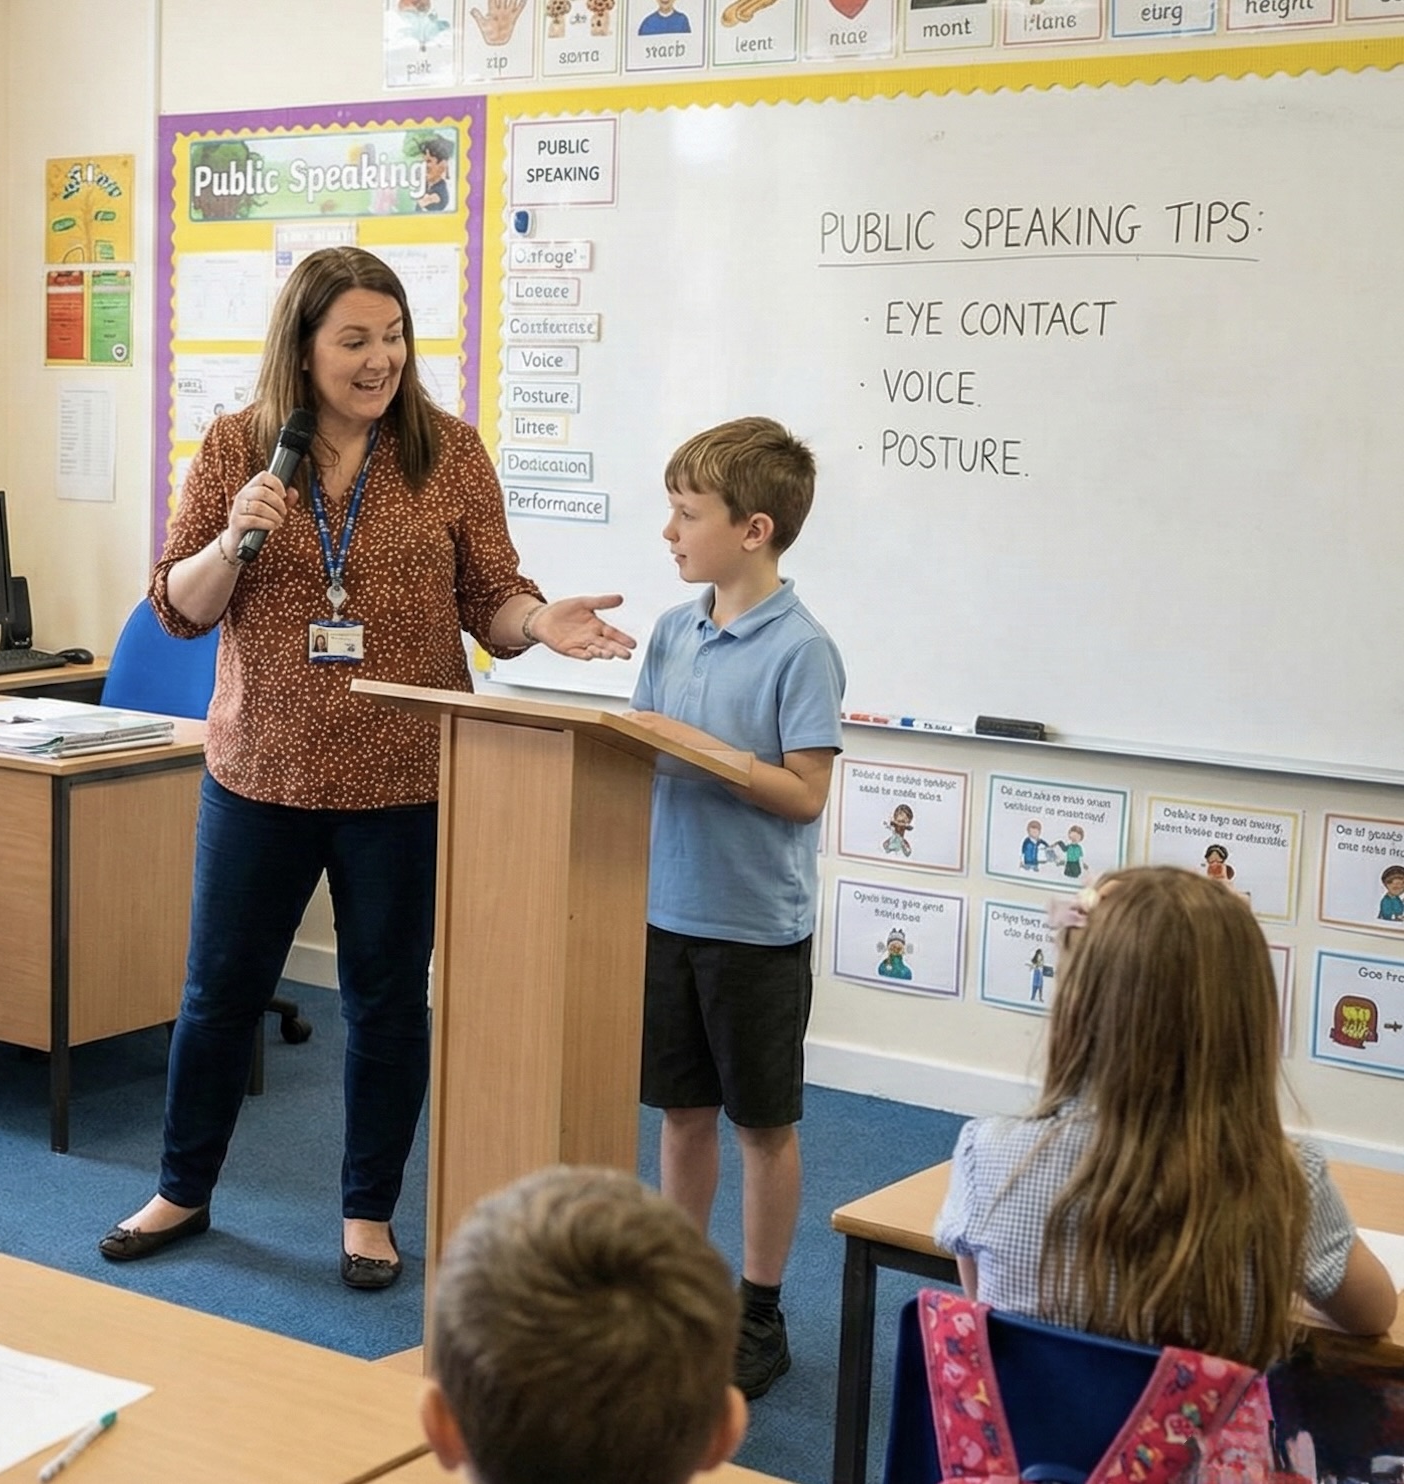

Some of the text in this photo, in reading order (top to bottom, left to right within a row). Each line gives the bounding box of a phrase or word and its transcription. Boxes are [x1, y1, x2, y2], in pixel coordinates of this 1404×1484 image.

[923, 17, 972, 38] mont
[537, 138, 590, 155] PUBLIC
[195, 153, 427, 203] Public Speaking
[526, 165, 600, 183] SPEAKING
[821, 201, 1264, 254] PUBLIC SPEAKING TIPS:
[886, 300, 1118, 337] EYE CONTACT
[521, 351, 564, 368] Voice
[882, 429, 1030, 477] POSTURE.
[508, 490, 603, 515] Performance
